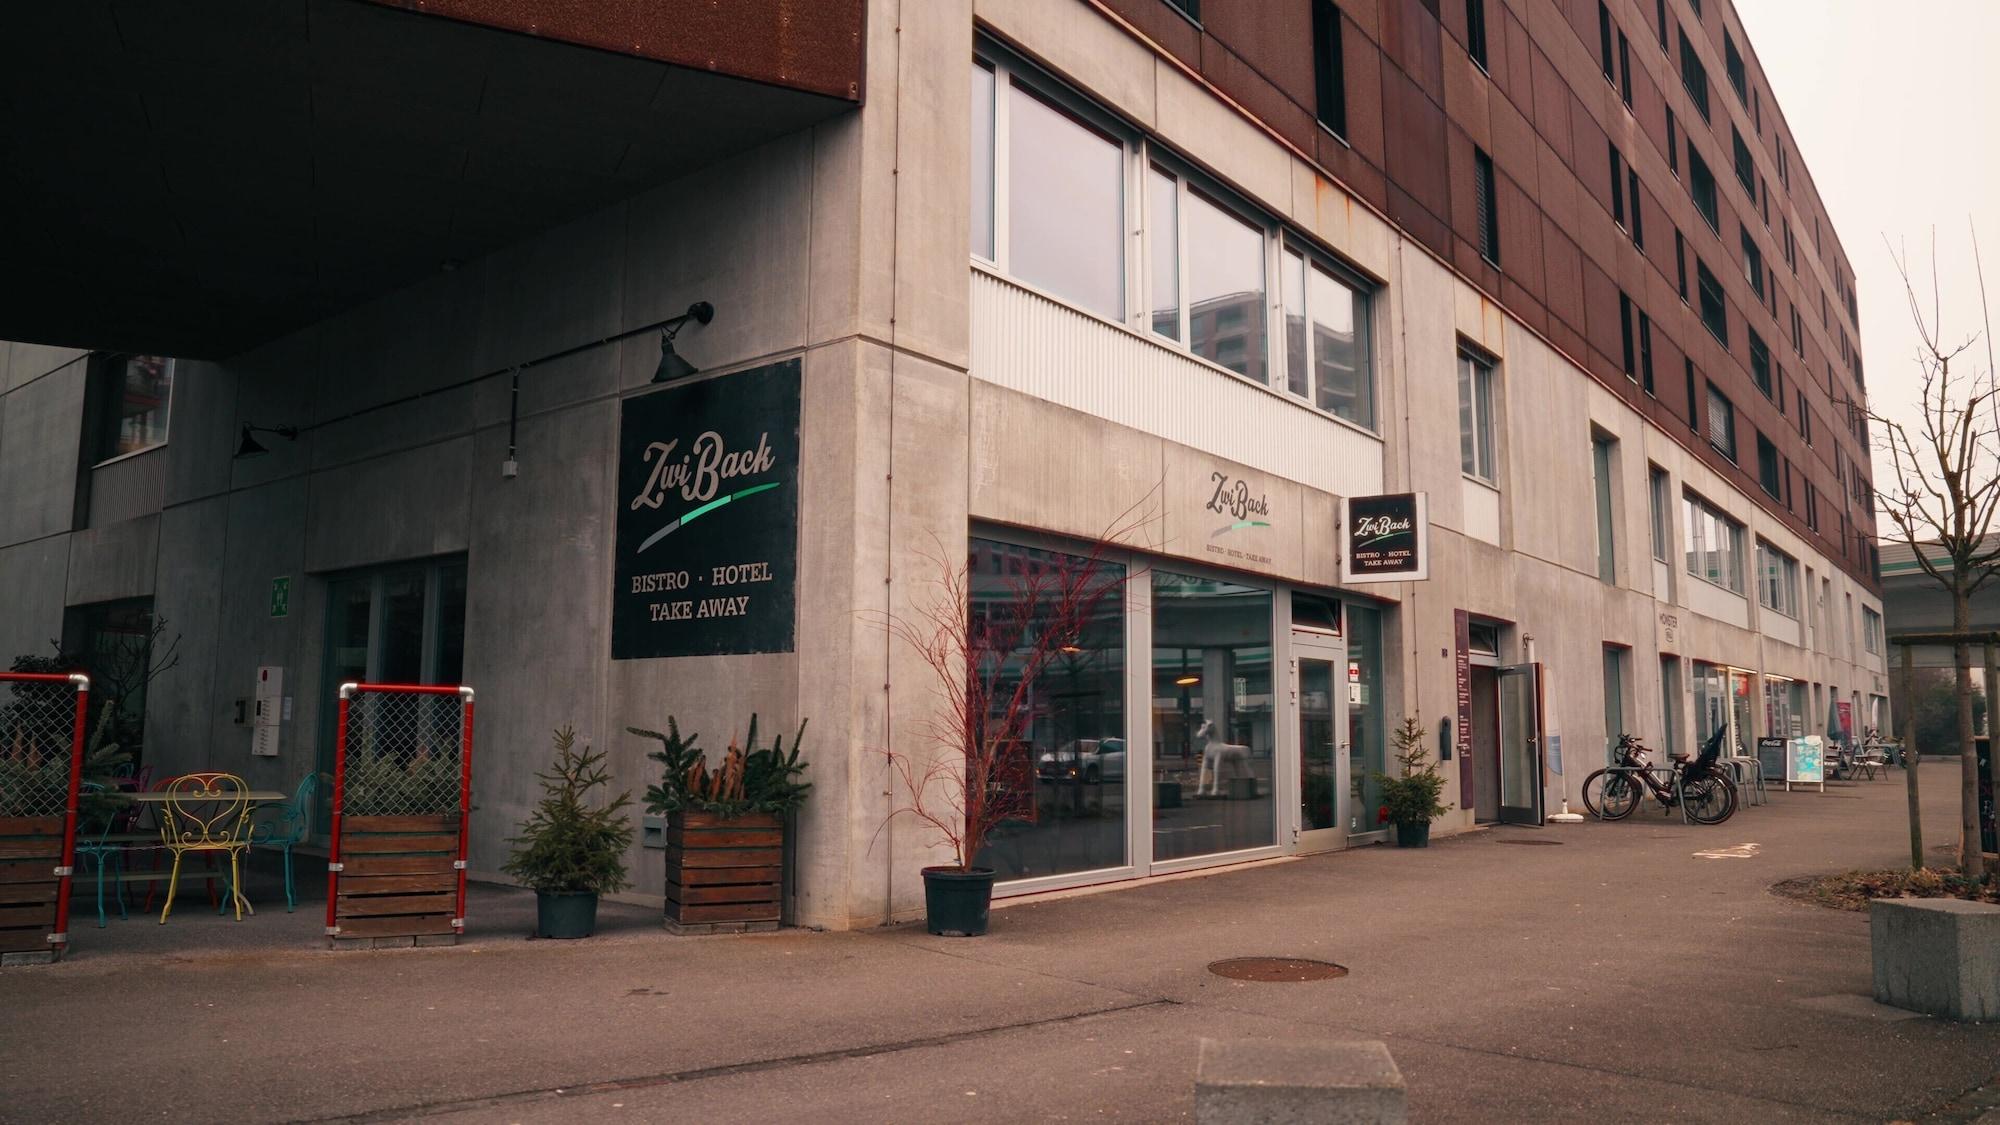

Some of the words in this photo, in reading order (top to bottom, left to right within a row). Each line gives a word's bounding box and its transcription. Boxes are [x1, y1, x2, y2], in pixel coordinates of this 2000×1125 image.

[631, 430, 775, 509] ZwiBack
[1383, 558, 1403, 566] AWAY
[631, 571, 689, 594] BISTRO
[712, 562, 772, 586] HOTEL
[650, 602, 693, 621] TAKE
[697, 596, 749, 619] AWAY
